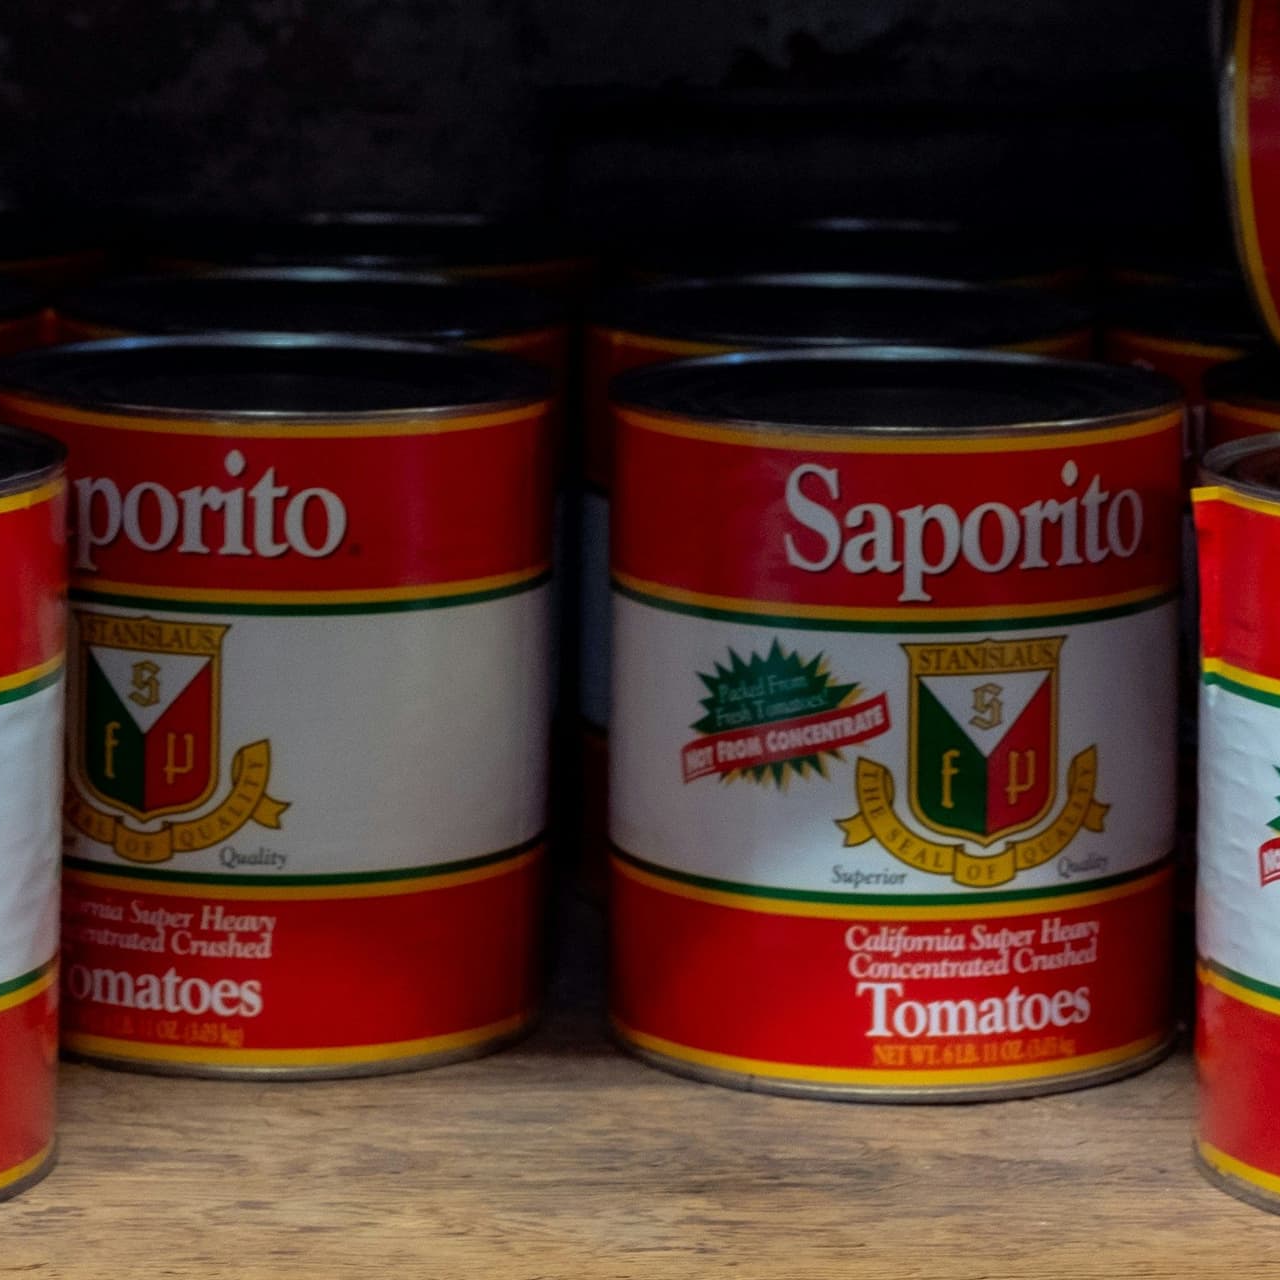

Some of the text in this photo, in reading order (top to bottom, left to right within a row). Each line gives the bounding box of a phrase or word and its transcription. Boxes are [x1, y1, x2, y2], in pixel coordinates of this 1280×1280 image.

[73, 450, 348, 571] porito
[784, 459, 1143, 603] Saporito
[920, 646, 1052, 672] STANISLAUS
[687, 709, 884, 773] NOT FROM CONCENTRATE
[221, 846, 288, 868] Quality
[832, 865, 907, 888] Superior
[200, 907, 276, 931] Heavy
[846, 919, 1099, 951] California Super Heavy
[171, 931, 273, 959] Crushed
[848, 944, 1097, 979] Concentrated Crushed
[70, 966, 263, 1016] omatoes
[857, 981, 1091, 1038] Tomatoes
